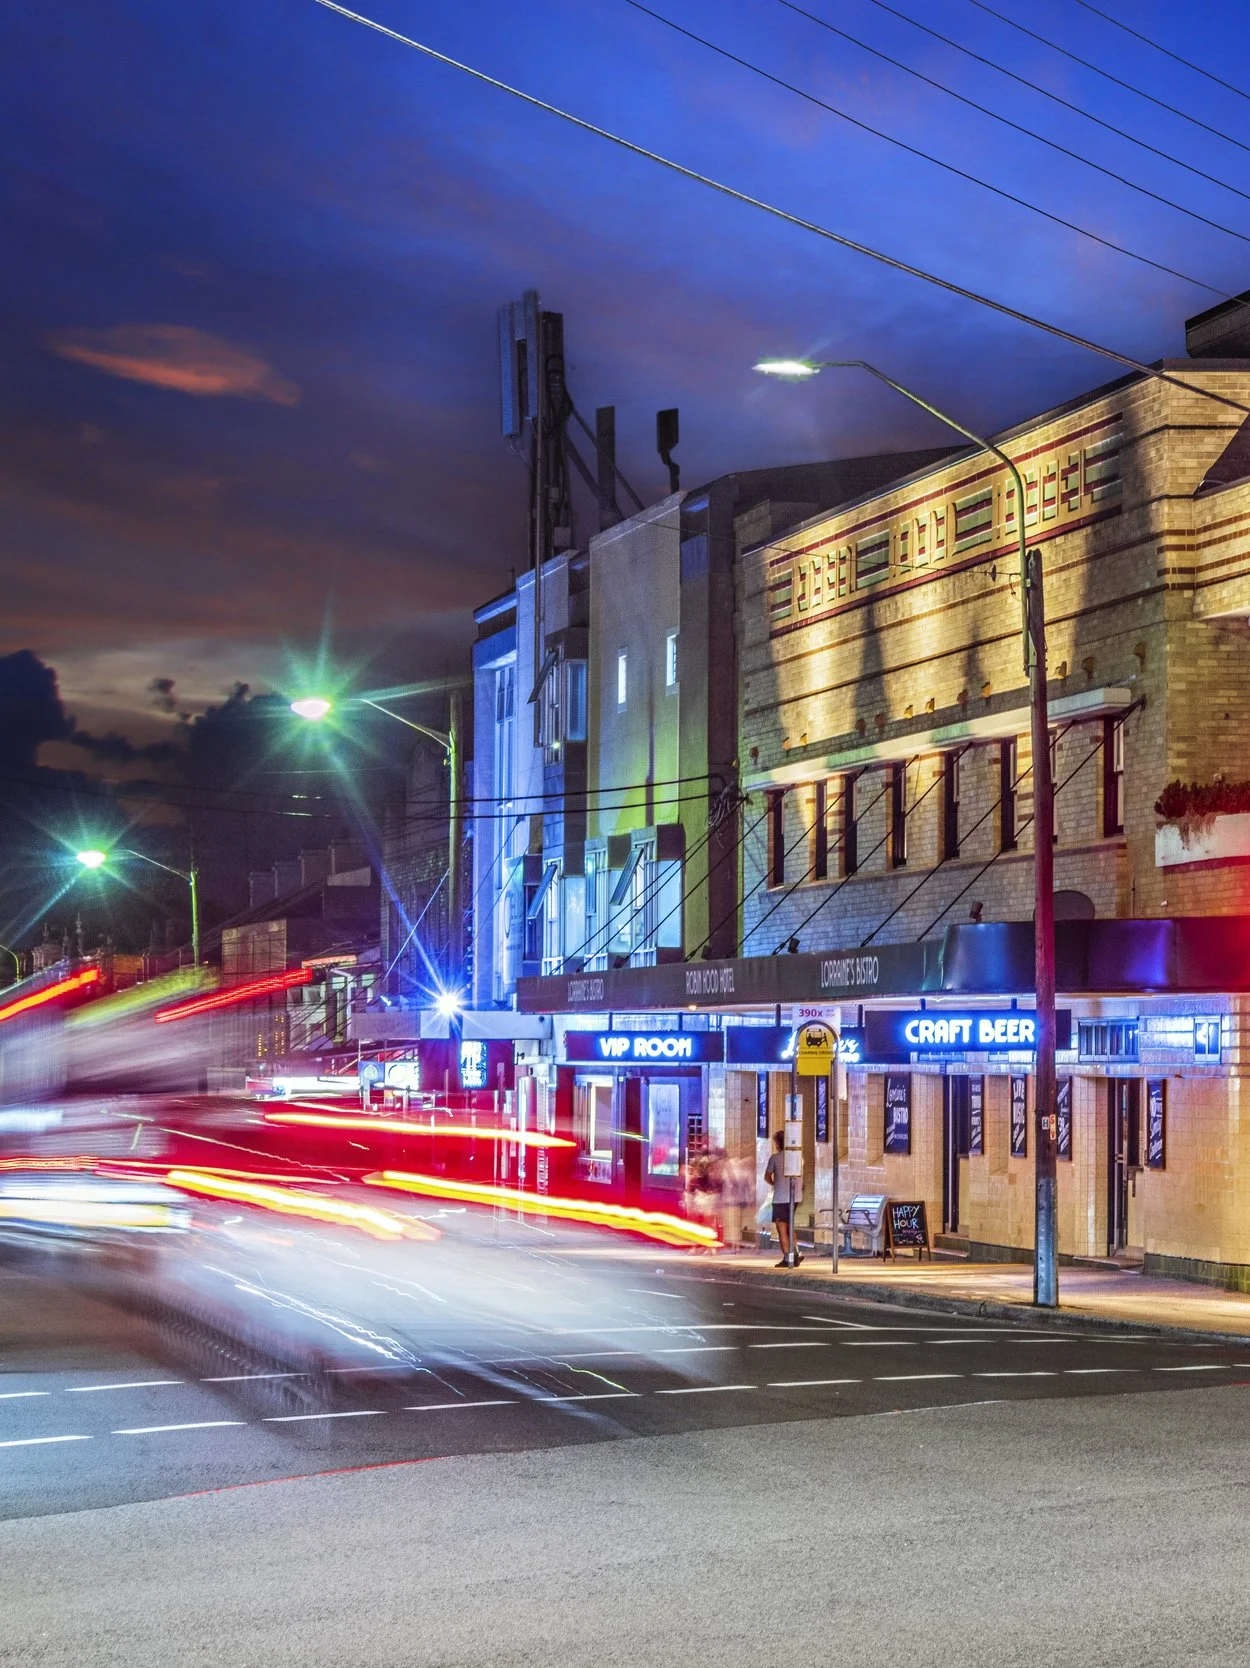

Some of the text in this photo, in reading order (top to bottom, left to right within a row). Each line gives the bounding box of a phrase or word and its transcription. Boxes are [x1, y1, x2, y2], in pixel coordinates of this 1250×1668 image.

[856, 956, 879, 985] BISTRO
[702, 969, 718, 994] HOOD
[719, 968, 735, 993] HOTEL
[798, 1008, 823, 1018] 390x
[905, 1019, 1035, 1043] CRAFT BEER
[600, 1037, 692, 1057] VIP ROOM
[892, 1205, 920, 1219] HAPPY
[893, 1218, 919, 1230] HOUR
